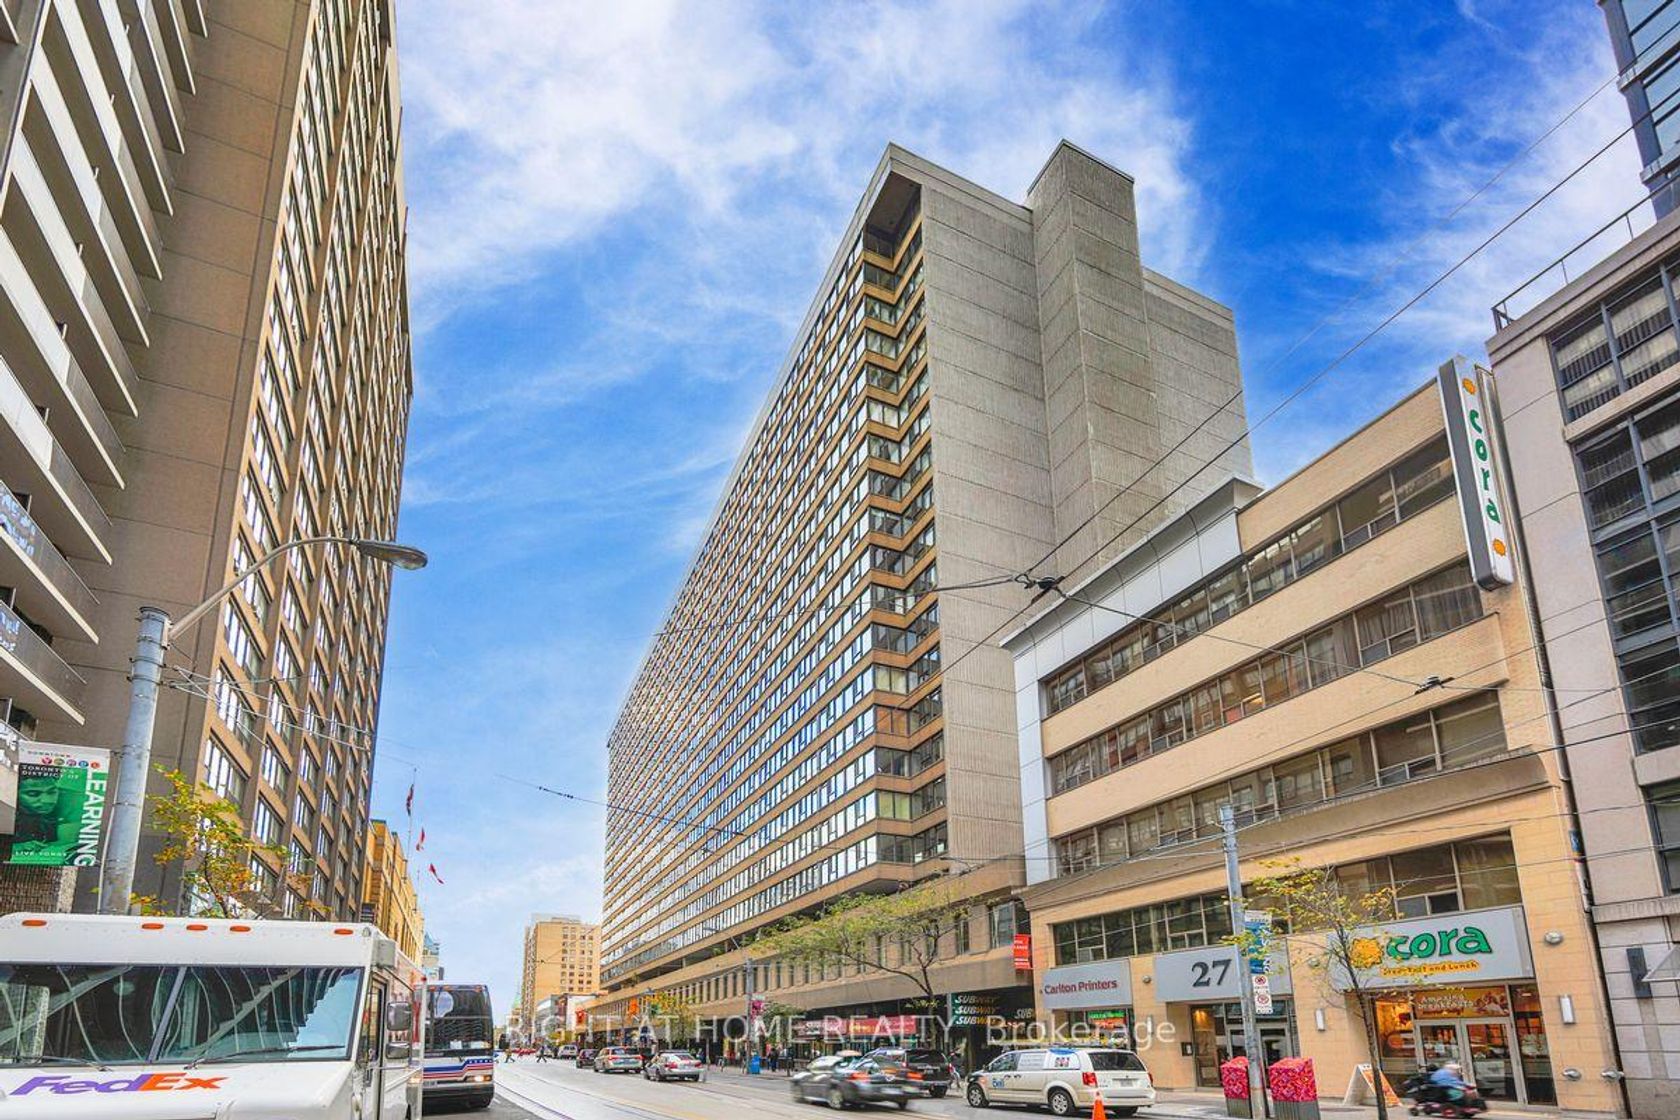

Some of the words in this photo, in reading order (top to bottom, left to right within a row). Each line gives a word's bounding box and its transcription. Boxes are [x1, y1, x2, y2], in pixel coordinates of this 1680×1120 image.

[1469, 409, 1501, 525] cora
[73, 766, 107, 867] LEARNING
[1386, 926, 1493, 961] cora
[1044, 982, 1077, 996] Carlton
[1078, 978, 1118, 993] Printers
[1191, 958, 1232, 988] 27
[9, 1073, 229, 1096] FedEx
